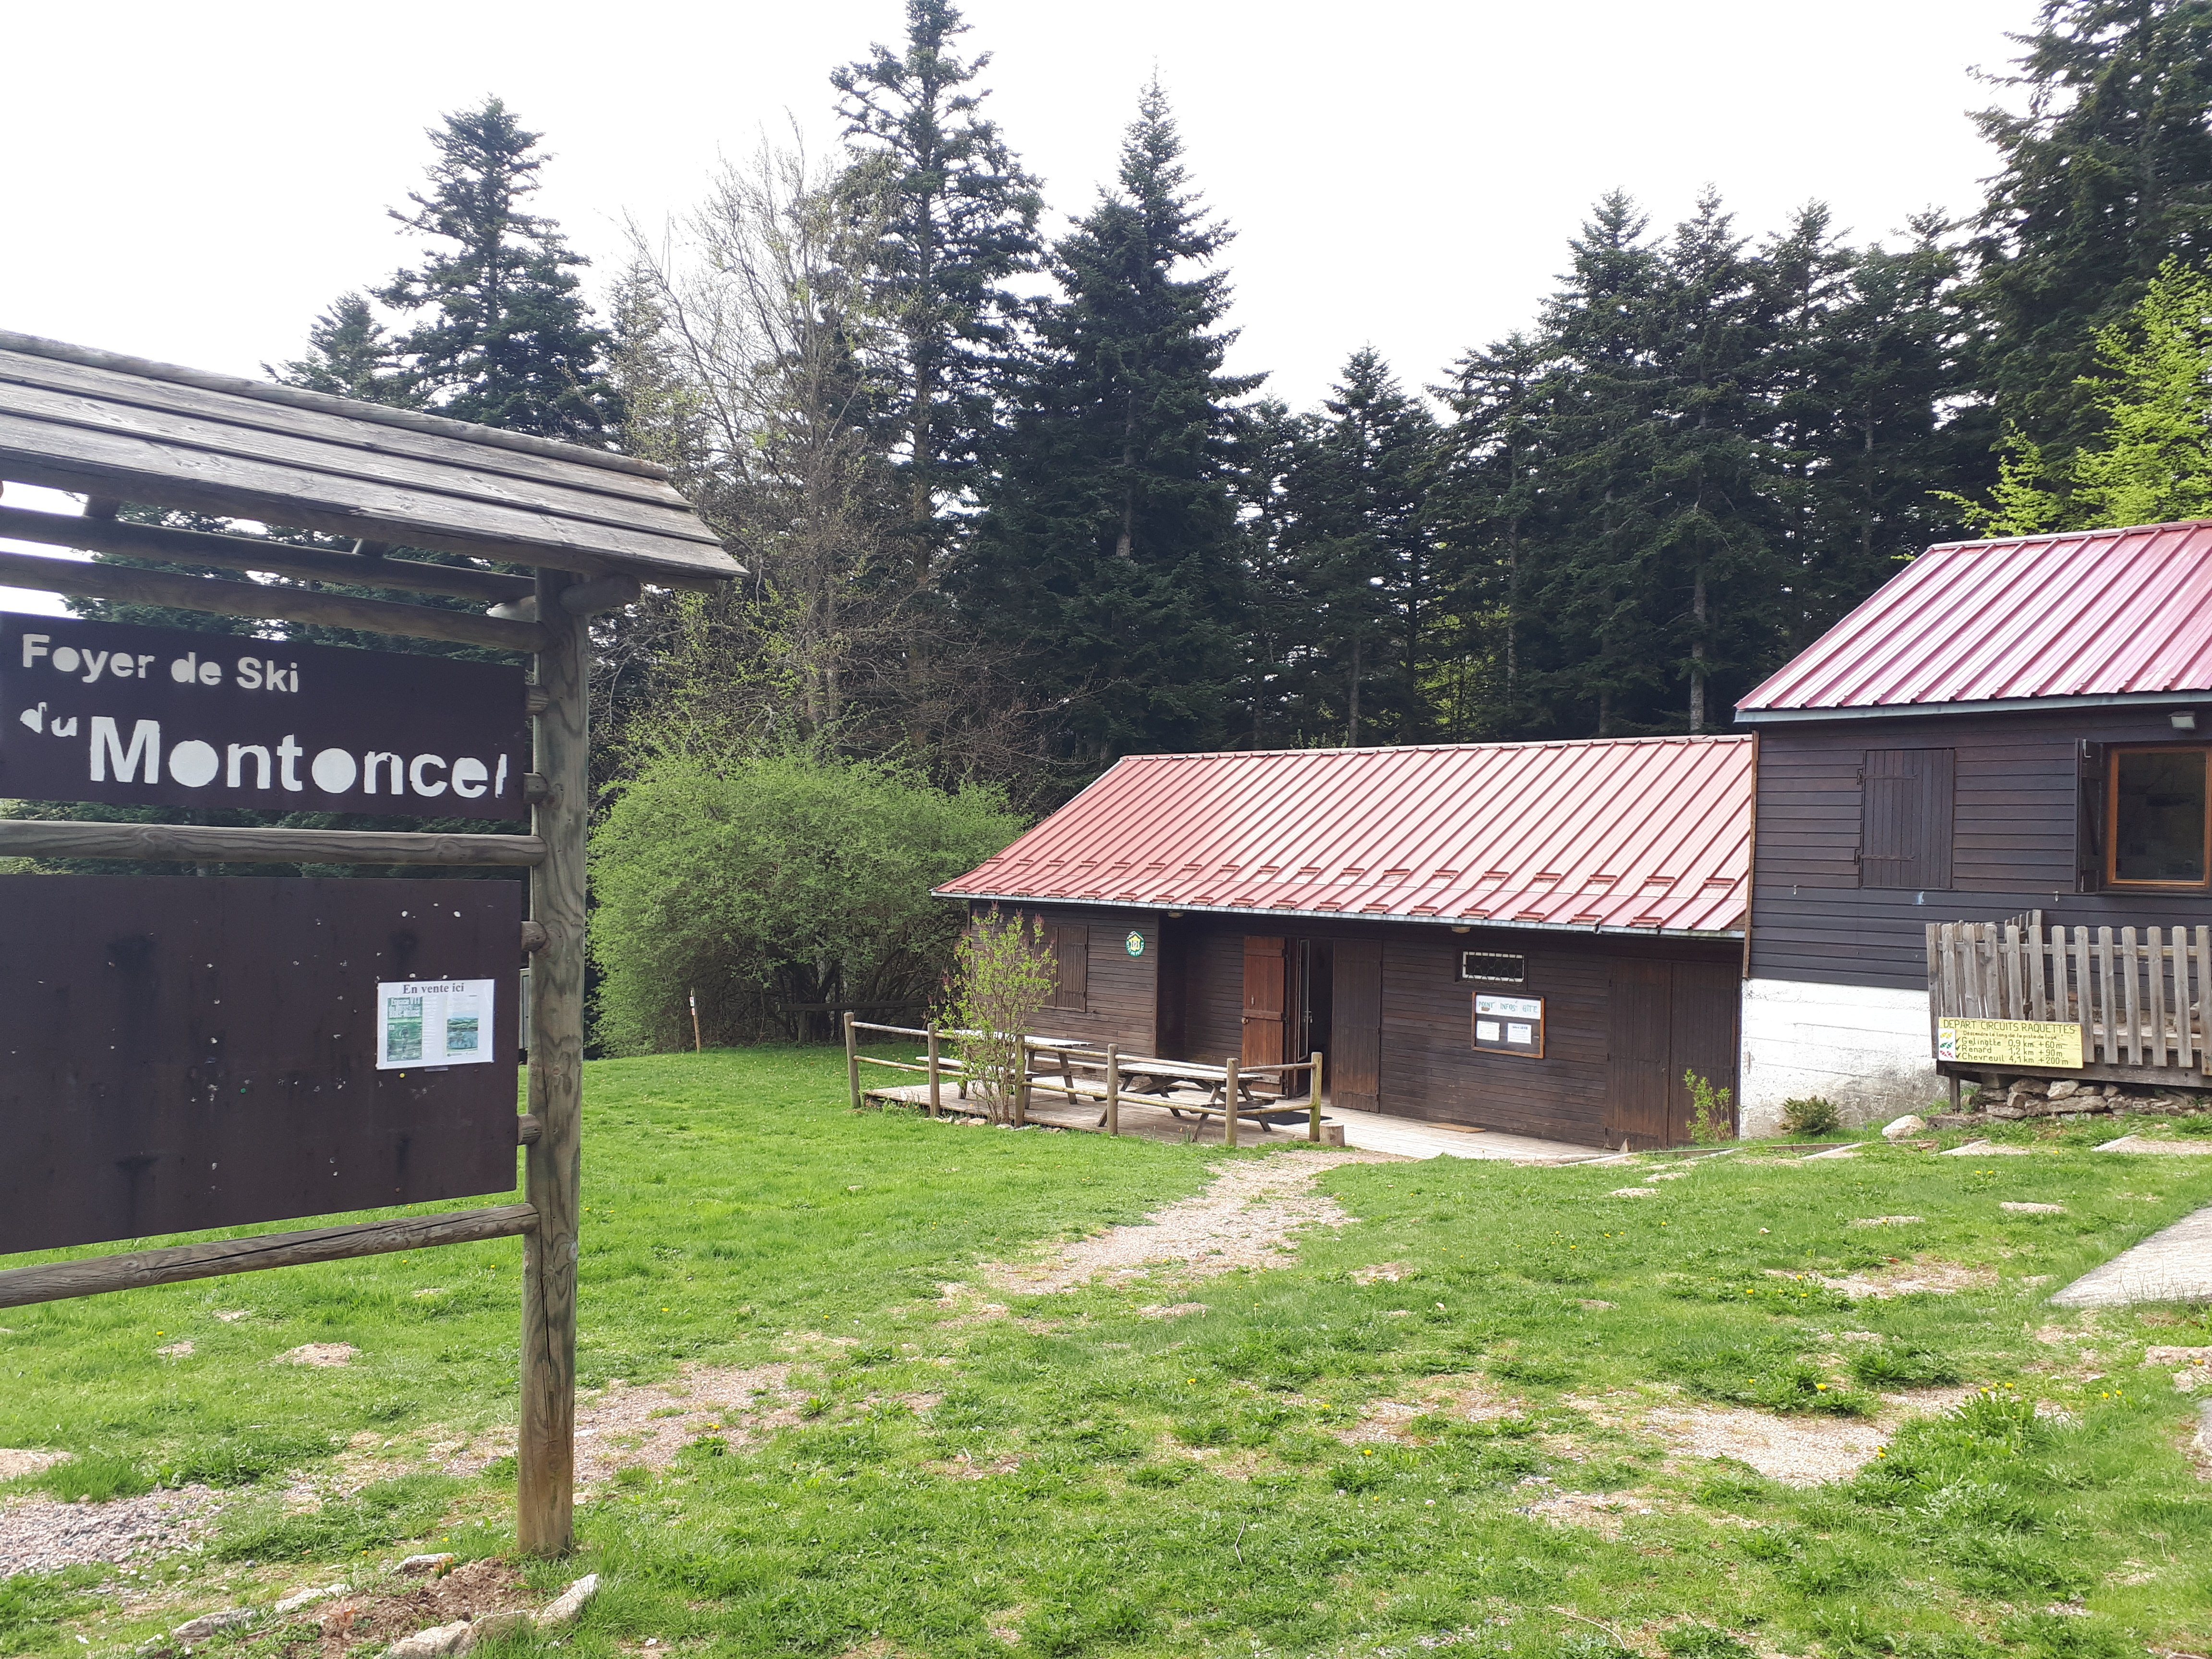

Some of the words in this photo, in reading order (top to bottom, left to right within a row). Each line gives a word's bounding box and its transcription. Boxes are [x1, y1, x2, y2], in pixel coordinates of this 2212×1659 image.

[22, 634, 156, 683] Foyer
[170, 652, 222, 685] de
[236, 656, 299, 692] Ski
[20, 701, 78, 737] du
[90, 716, 507, 798] Montoncel
[403, 985, 418, 994] En
[421, 985, 449, 993] vente
[452, 983, 464, 992] ici
[1943, 1019, 1977, 1029] DEPART
[1981, 1022, 2019, 1031] CIRCUITS
[2021, 1023, 2076, 1034] RAQUETTES
[2008, 1039, 2021, 1048] 0,9
[2023, 1039, 2034, 1047] km
[1961, 1045, 1992, 1053] Renard
[2008, 1047, 2021, 1056] 1,2
[2023, 1047, 2034, 1056] km
[1962, 1053, 2005, 1062] Chevreuil
